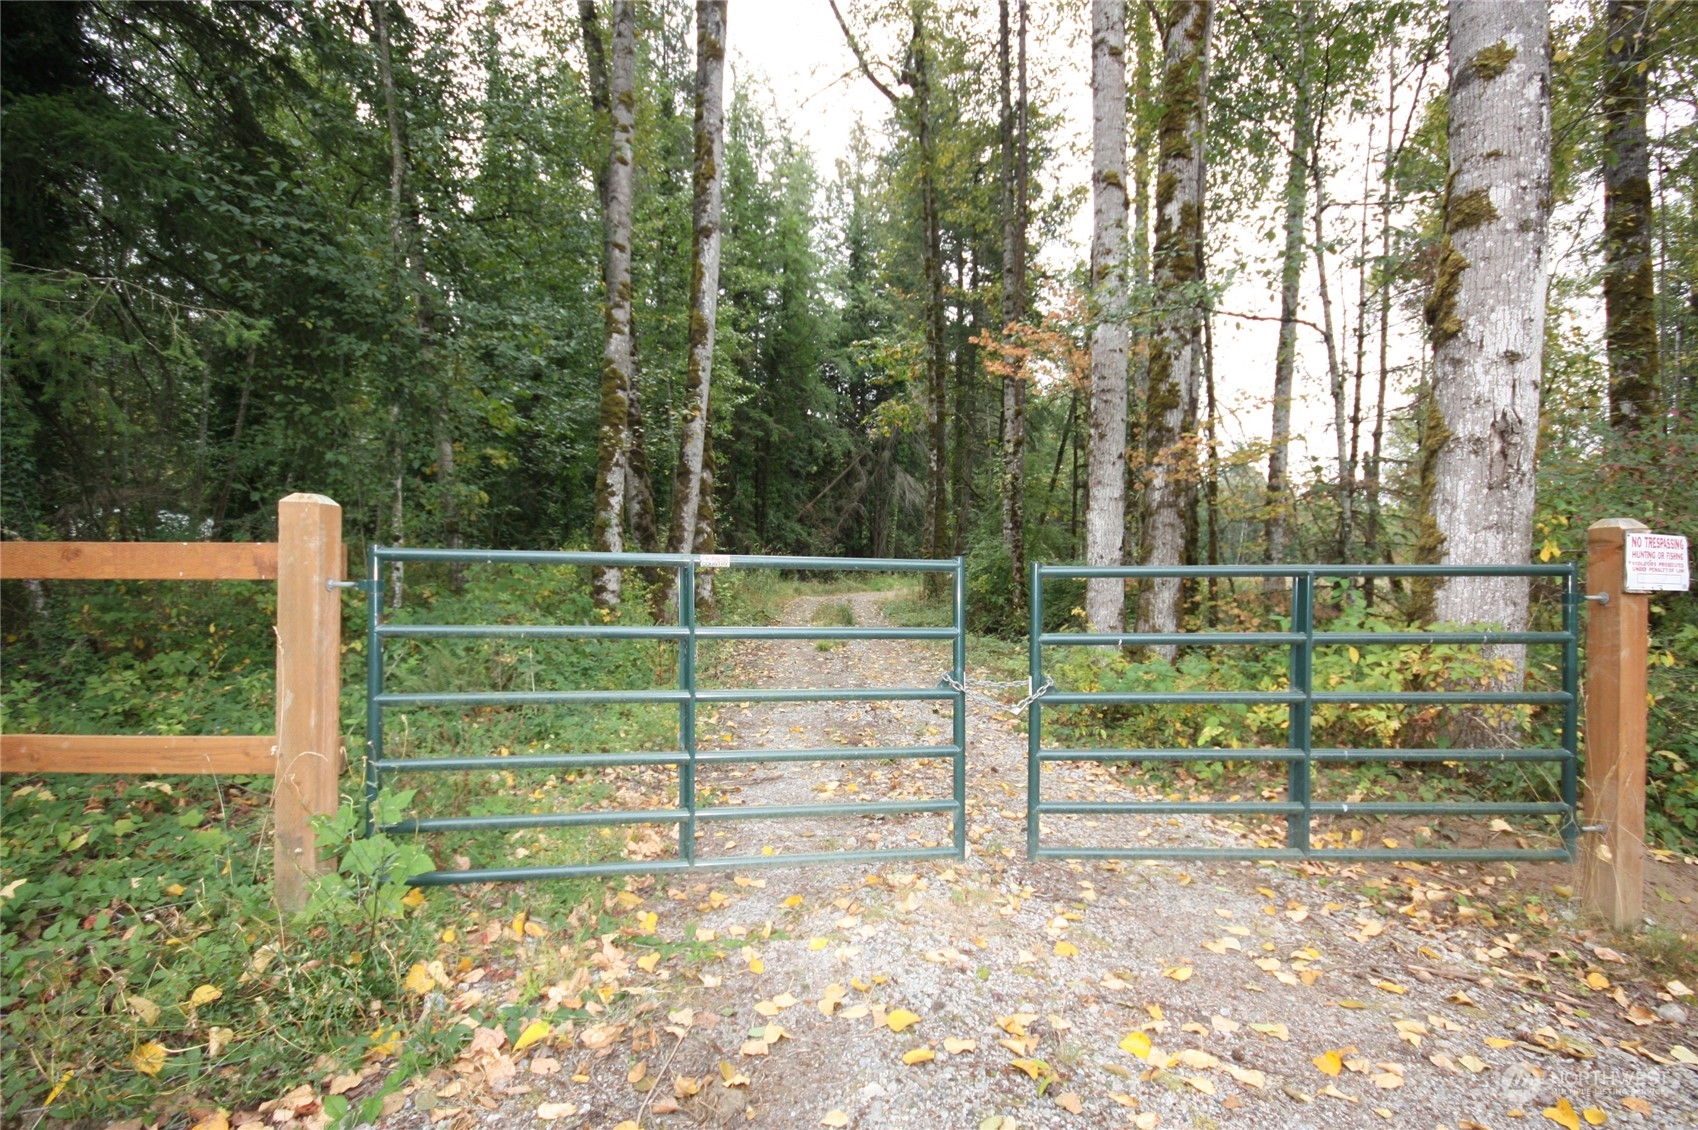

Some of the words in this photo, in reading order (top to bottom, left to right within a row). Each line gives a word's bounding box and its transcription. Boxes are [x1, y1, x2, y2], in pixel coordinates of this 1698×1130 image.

[1632, 536, 1642, 548] NO
[1644, 537, 1684, 550] TRESPASSING
[1632, 551, 1656, 559] HUNTING
[1666, 552, 1684, 560] FISHING
